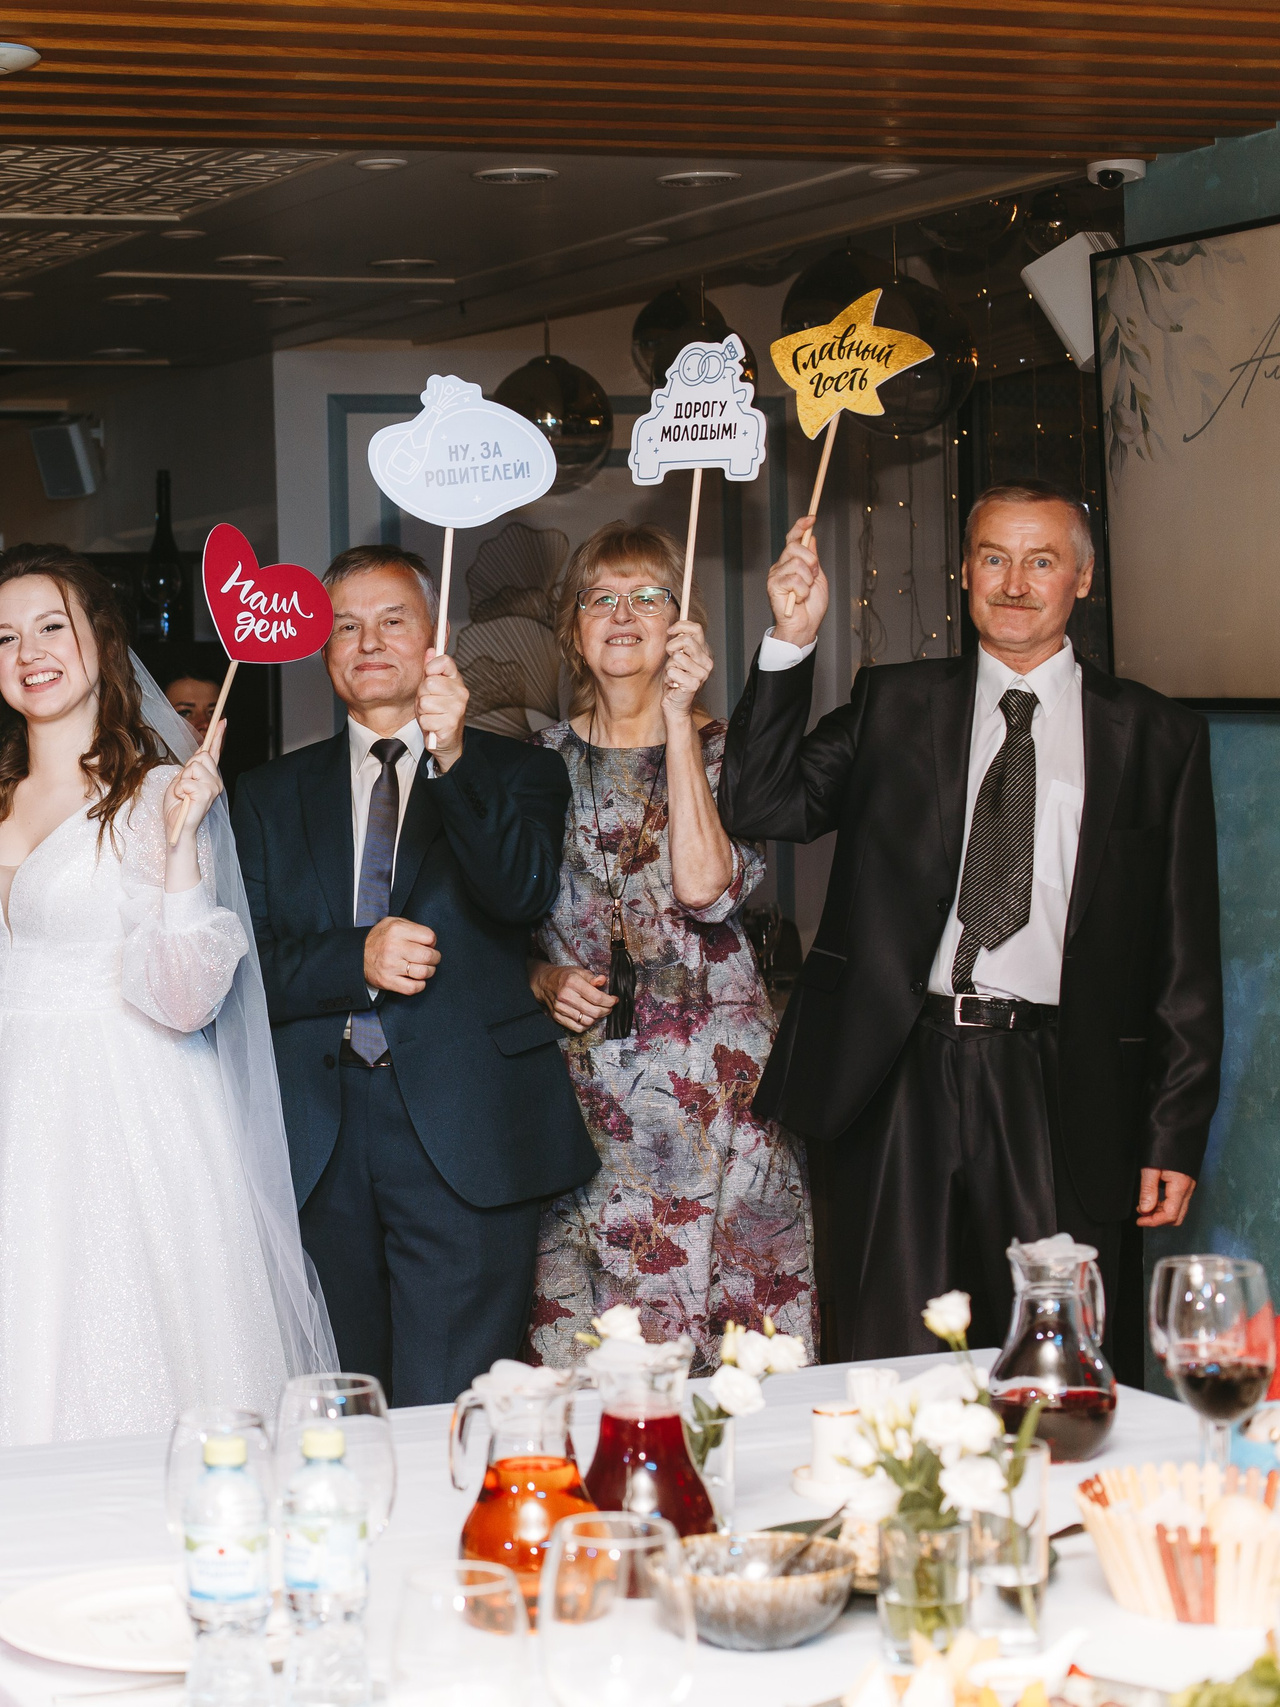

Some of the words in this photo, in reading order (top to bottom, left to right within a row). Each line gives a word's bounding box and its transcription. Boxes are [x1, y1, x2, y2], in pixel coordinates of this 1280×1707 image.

[792, 323, 897, 375] Главный
[809, 368, 870, 398] гость
[673, 400, 728, 419] ДОРОГУ
[660, 422, 737, 442] МОЛОДЫМ!
[448, 443, 476, 462] НУ,
[480, 441, 503, 460] ЗА
[424, 458, 531, 488] РОДИТЕЛЕЙ!
[234, 611, 297, 643] день
